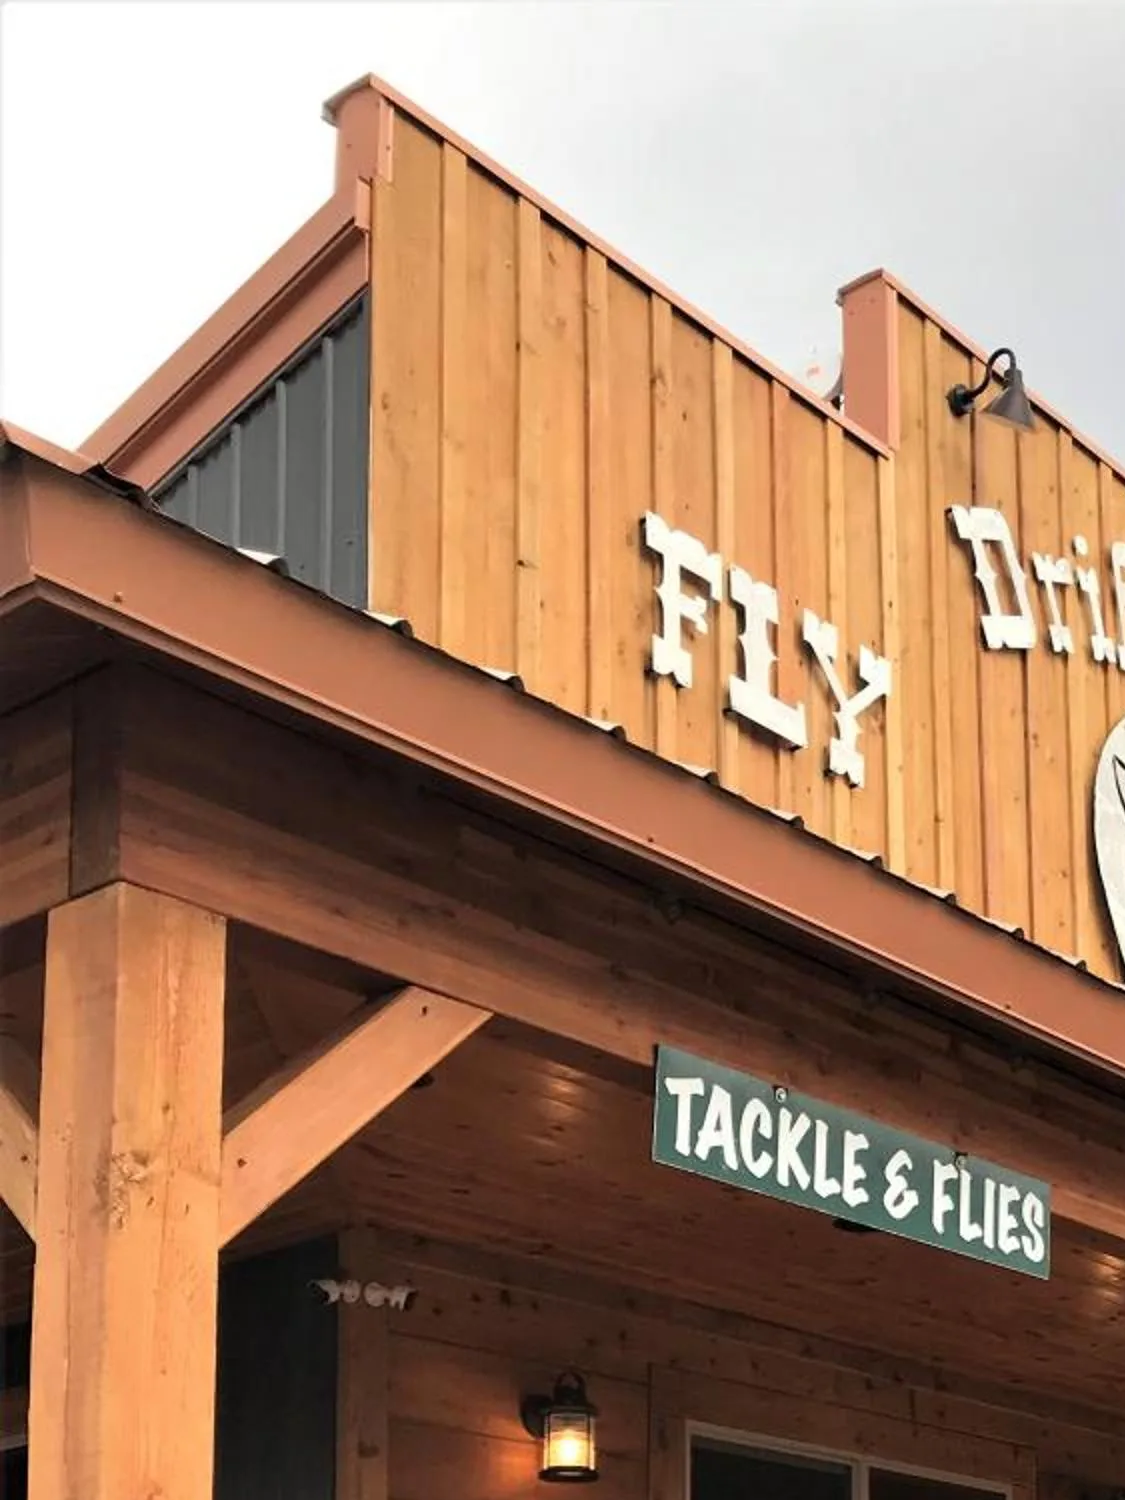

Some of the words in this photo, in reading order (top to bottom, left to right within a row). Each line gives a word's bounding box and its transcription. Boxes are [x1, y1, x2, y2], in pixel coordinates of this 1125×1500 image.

[641, 511, 893, 788] FLY
[665, 1076, 870, 1208] TACKLE
[883, 1149, 919, 1220] &
[932, 1158, 1046, 1263] FLIES
